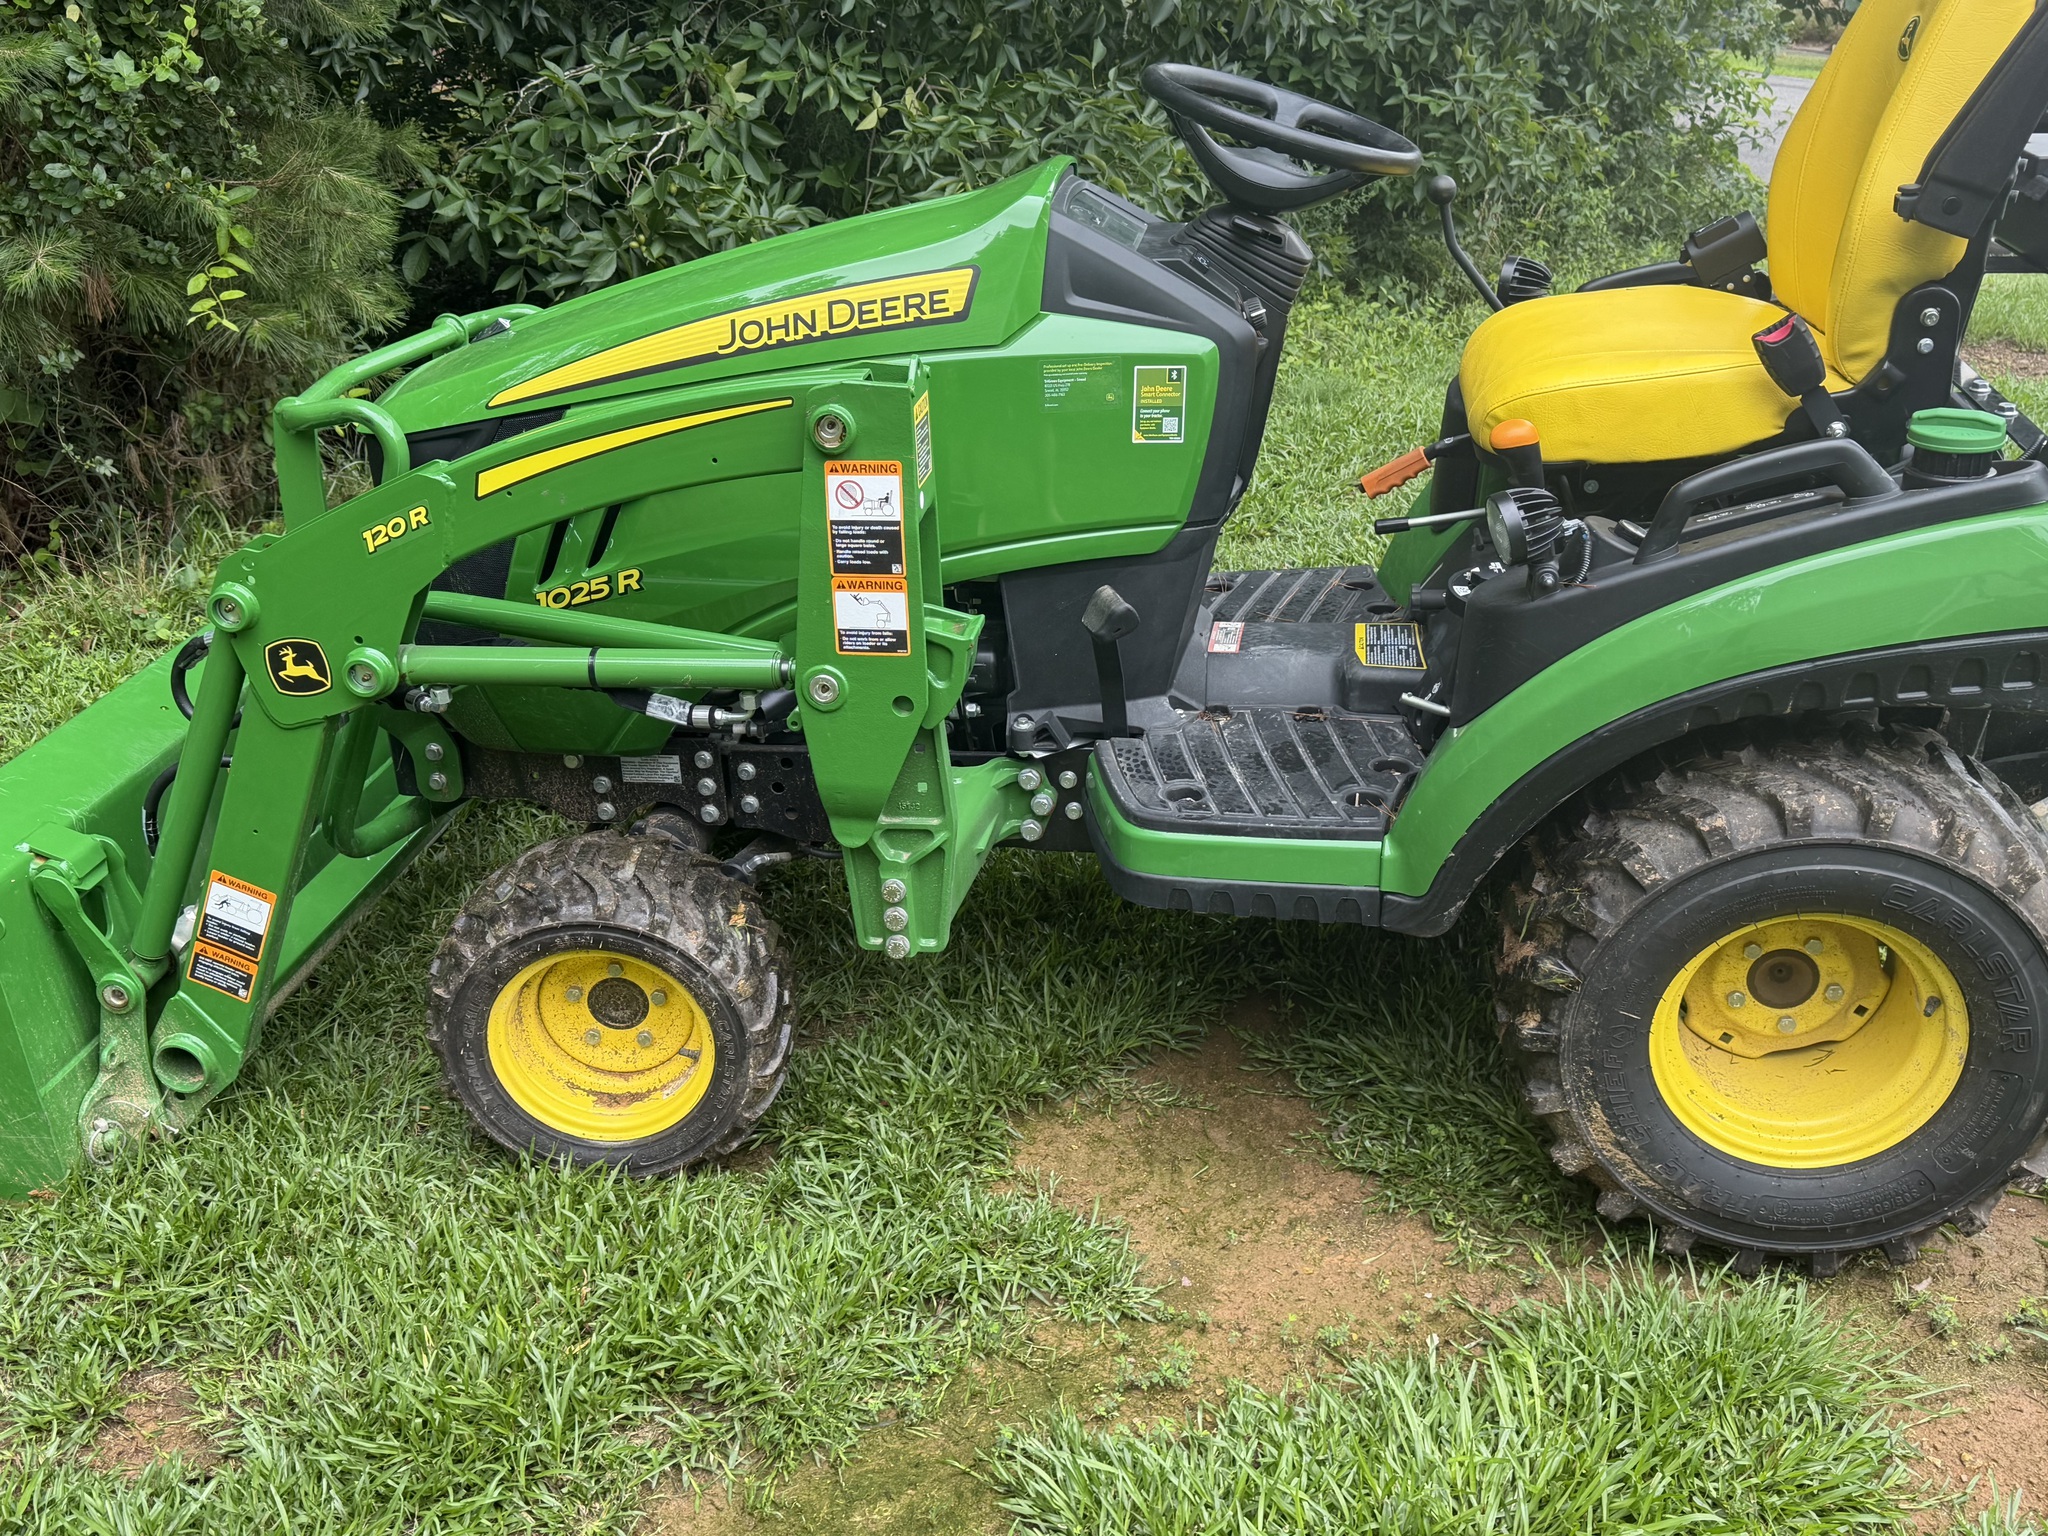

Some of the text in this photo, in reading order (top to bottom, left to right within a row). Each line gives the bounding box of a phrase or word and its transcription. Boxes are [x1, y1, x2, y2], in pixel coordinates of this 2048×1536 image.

[717, 288, 950, 350] JOHN DEERE
[840, 464, 898, 474] WARNING
[362, 505, 432, 554] 120 R
[535, 568, 644, 608] 1025 R
[846, 580, 903, 590] WARNING
[228, 879, 268, 900] WARNING
[212, 950, 250, 971] WARNING
[1881, 882, 2033, 1054] CARLSTAR
[715, 1019, 736, 1110] CARLSTAR
[1603, 1049, 1652, 1147] CHIEF
